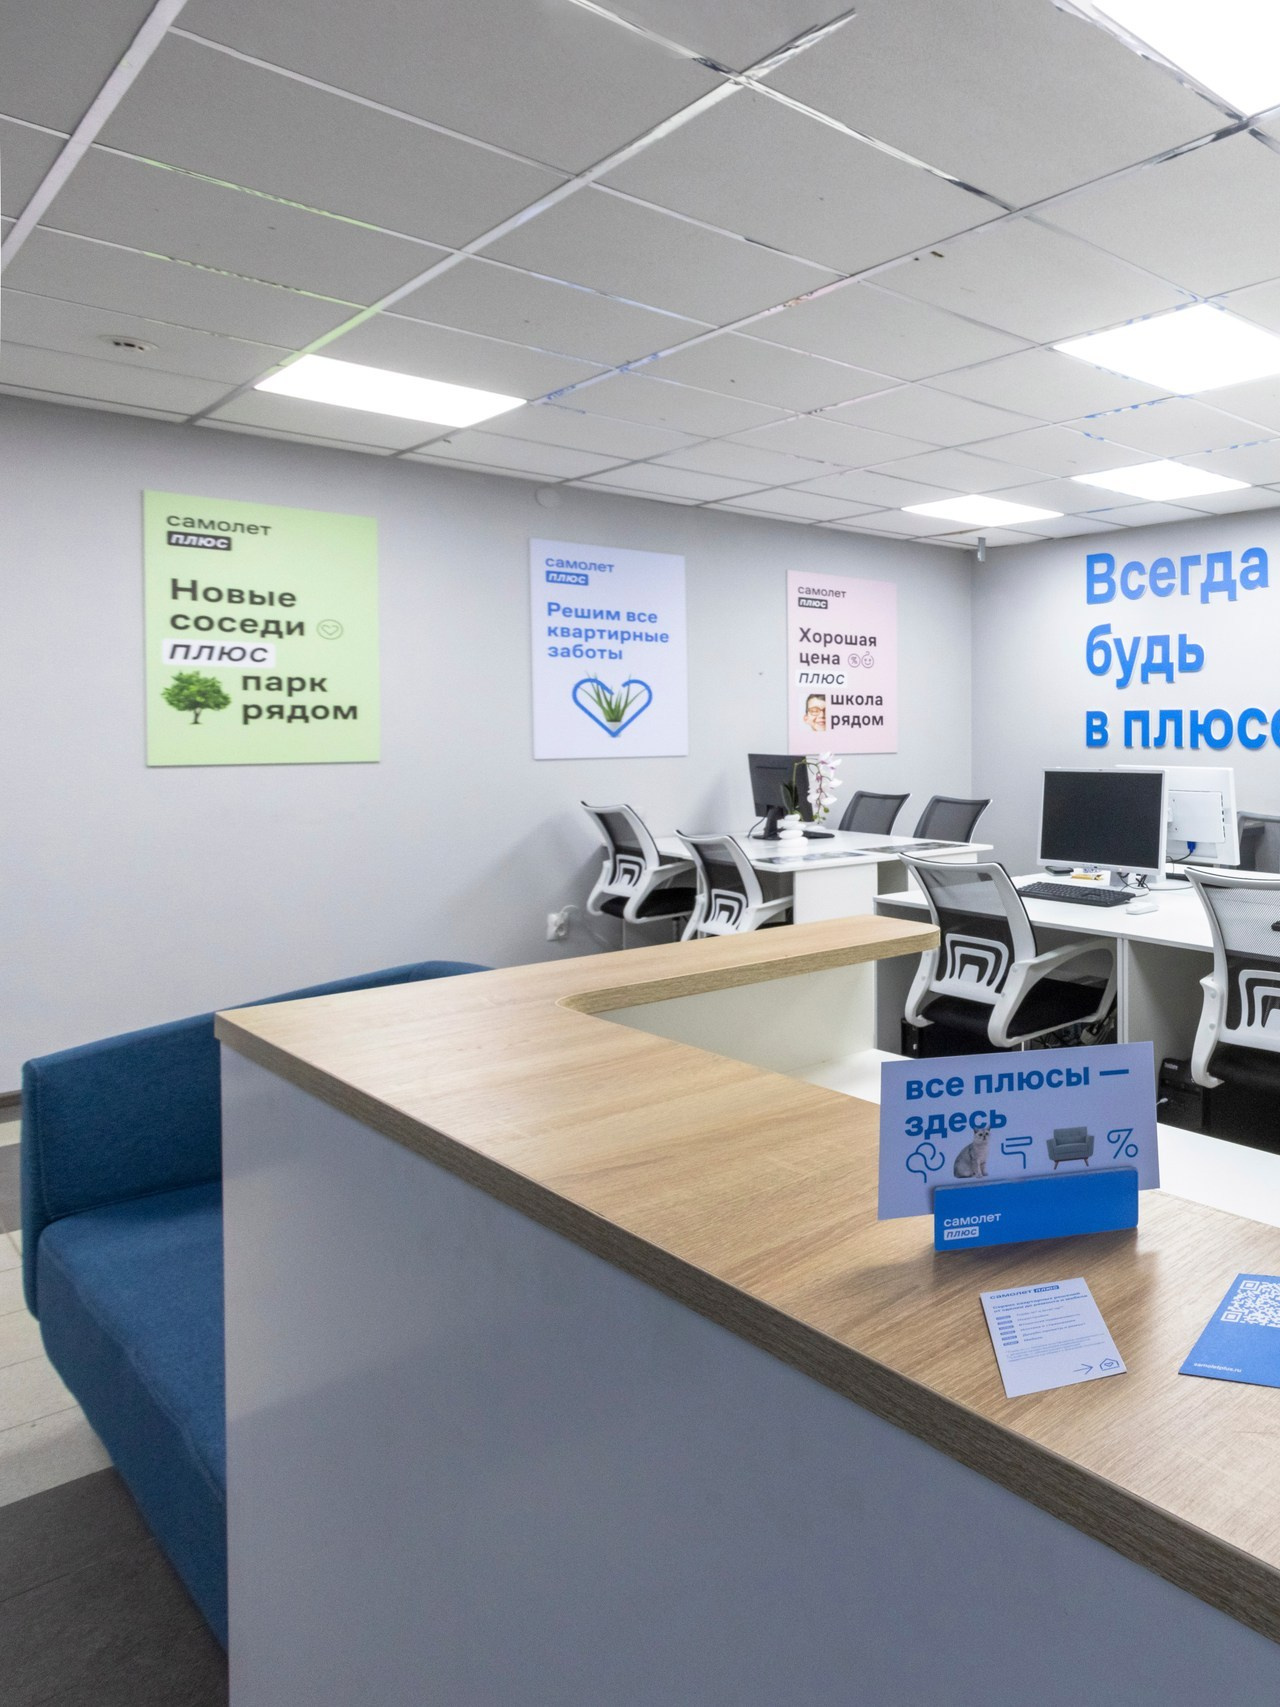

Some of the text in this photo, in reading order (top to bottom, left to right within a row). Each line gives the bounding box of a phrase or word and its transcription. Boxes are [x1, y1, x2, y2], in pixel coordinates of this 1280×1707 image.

[166, 515, 272, 536] самолет
[170, 533, 229, 549] плюс
[545, 557, 615, 573] самолет
[548, 572, 586, 584] плюс
[1086, 546, 1270, 605] Всегда
[170, 578, 297, 608] Новые
[798, 585, 847, 599] самолет
[547, 602, 658, 623] Решим все
[799, 598, 827, 608] плюс
[170, 613, 305, 639] соседи
[547, 625, 670, 644] квартирные
[799, 627, 877, 647] Хорошая
[169, 643, 269, 663] плюс
[547, 644, 623, 660] заботы
[799, 652, 840, 666] цена
[1085, 622, 1205, 690] будь
[242, 675, 328, 697] парк
[798, 672, 845, 685] плюс
[830, 694, 883, 706] школа
[242, 703, 358, 725] рядом
[830, 714, 884, 730] рядом
[1085, 710, 1109, 748] в
[905, 1076, 964, 1100] все
[973, 1066, 1090, 1095] плюсы
[905, 1109, 1007, 1140] здесь
[943, 1213, 1002, 1228] самолет
[945, 1228, 978, 1239] плюс
[990, 1290, 1032, 1300] самолет
